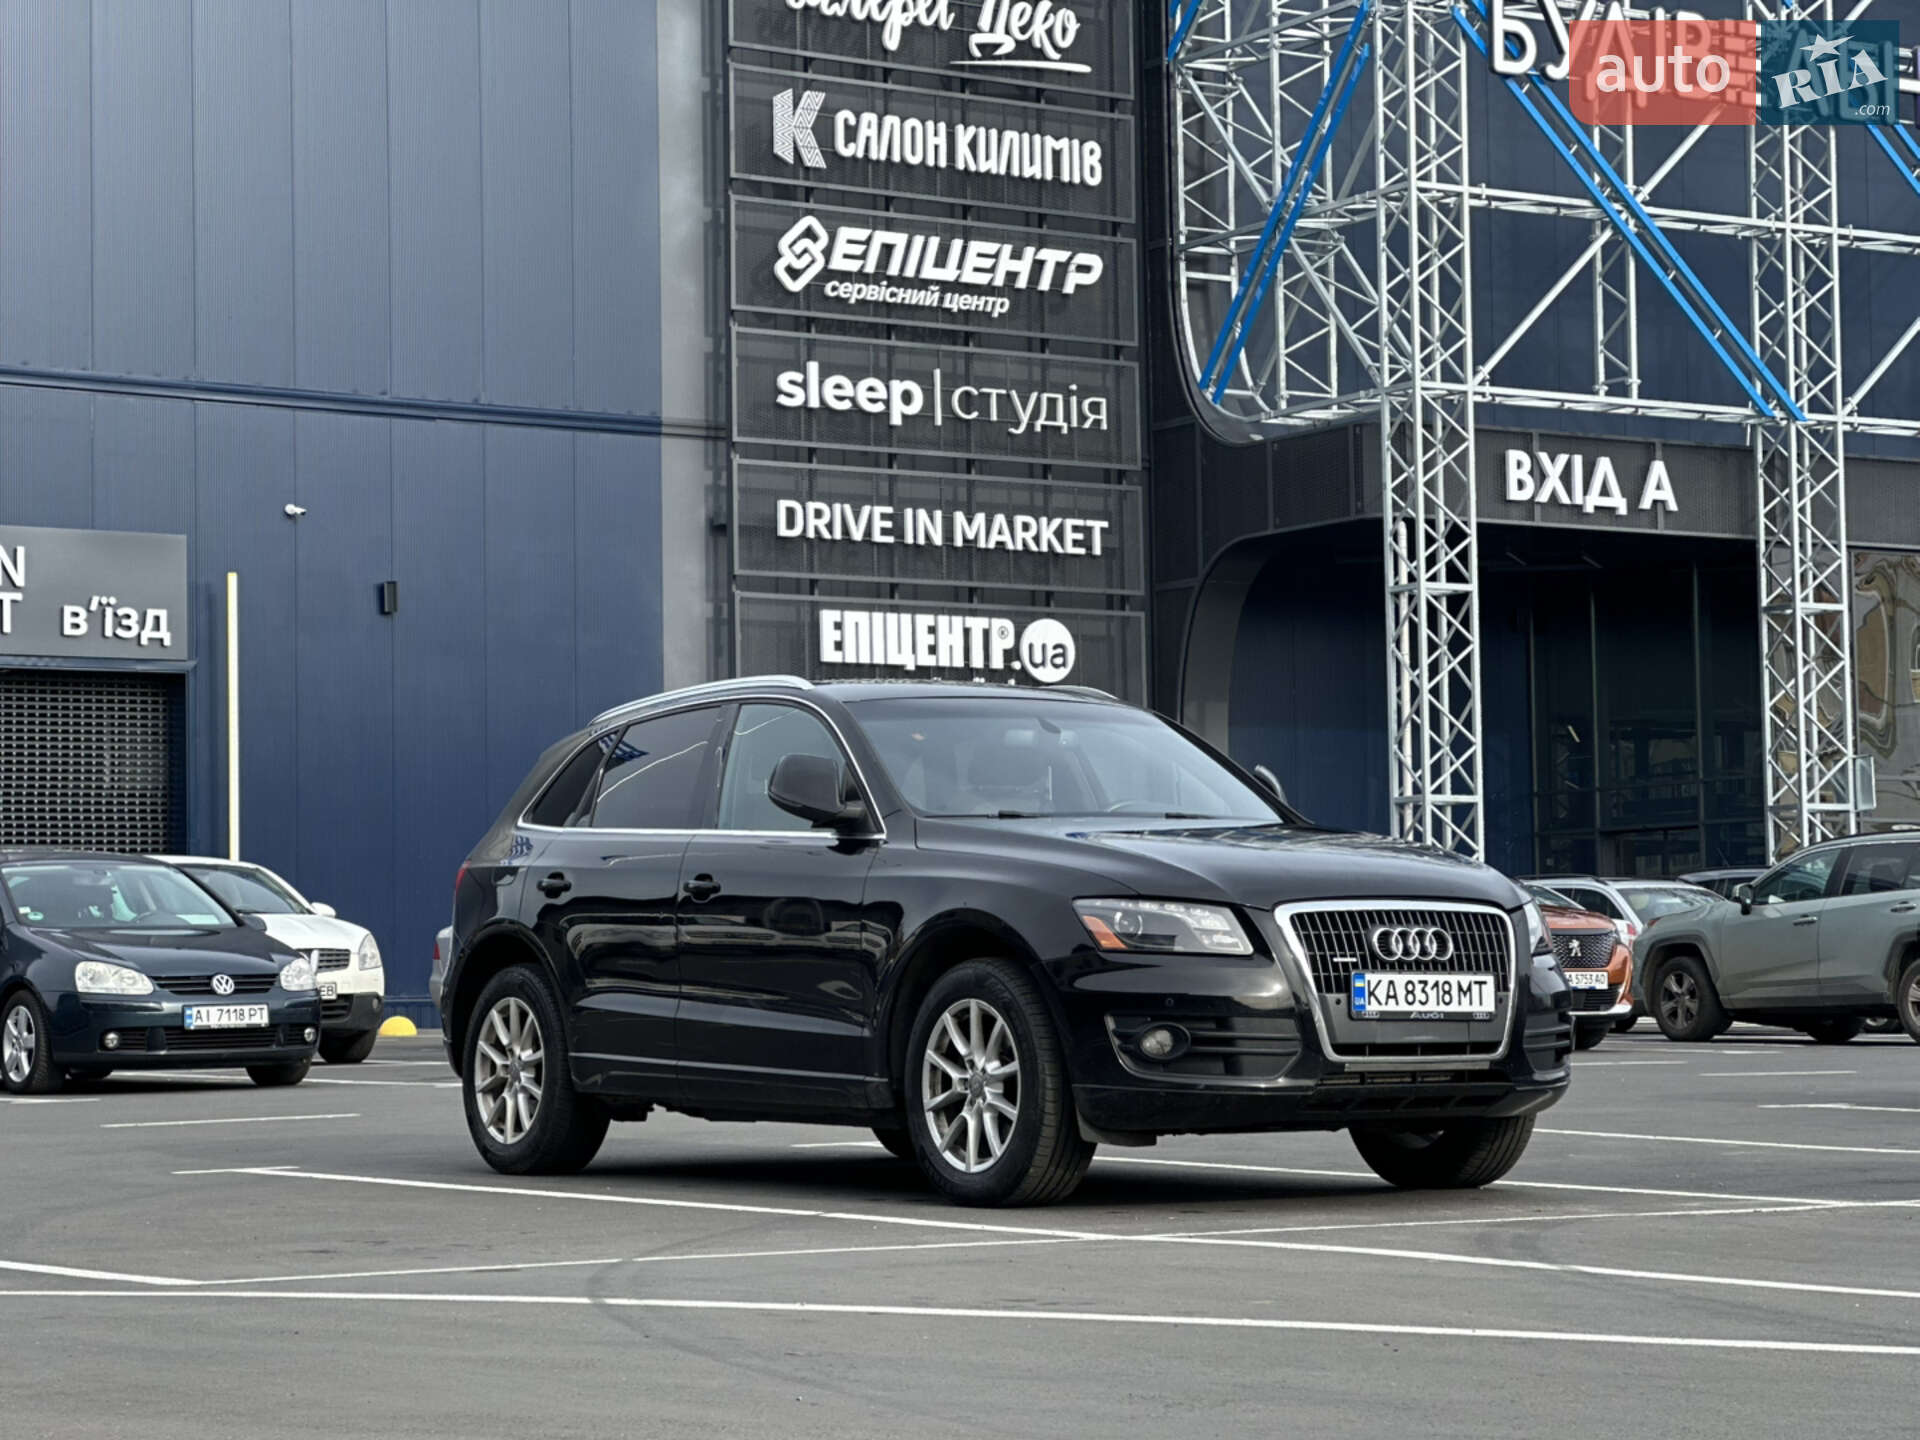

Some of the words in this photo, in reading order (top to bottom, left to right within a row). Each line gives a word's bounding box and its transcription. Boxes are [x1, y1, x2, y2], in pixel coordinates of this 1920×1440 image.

[834, 109, 947, 168] САЛОН
[955, 123, 1102, 186] КИЛИМІВ
[828, 226, 1104, 294] ЕПІЦЕНТР
[825, 278, 939, 307] сервісний
[943, 291, 1010, 317] центр
[776, 361, 924, 426] sleep
[951, 383, 1108, 435] студія
[1505, 449, 1628, 515] ВХІД
[1638, 460, 1679, 512] А
[776, 499, 894, 543] DRIVE
[903, 508, 943, 546] IN
[953, 510, 1109, 556] MARKET
[217, 1008, 245, 1022] 7118
[249, 1008, 265, 1021] PT
[1367, 980, 1399, 1006] KA
[1404, 980, 1453, 1006] 8318
[1457, 980, 1488, 1006] MT
